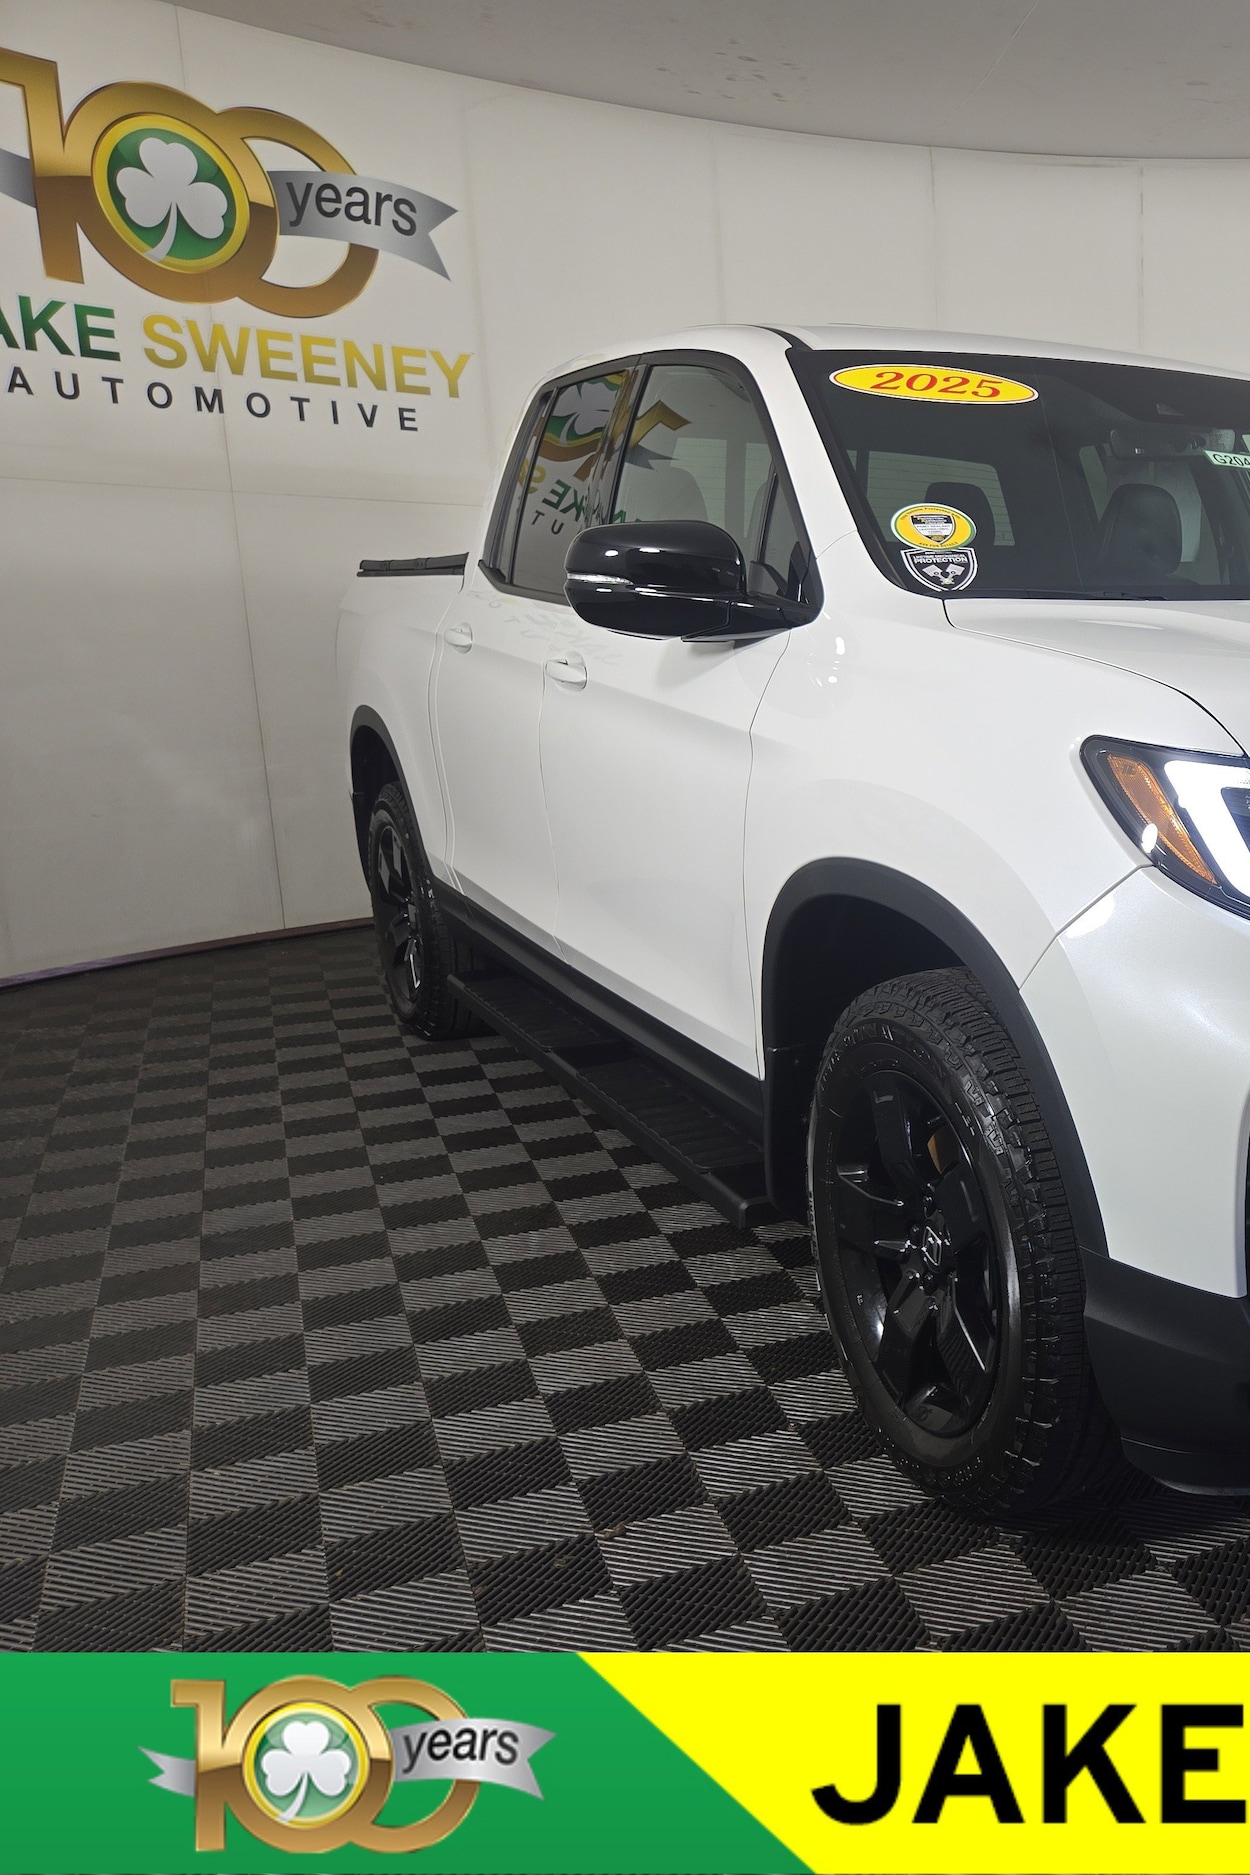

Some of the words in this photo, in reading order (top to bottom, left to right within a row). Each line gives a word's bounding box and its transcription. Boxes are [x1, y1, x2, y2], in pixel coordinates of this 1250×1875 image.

[286, 181, 418, 237] years
[142, 314, 472, 399] SWEENEY
[870, 371, 1003, 398] 2025
[7, 366, 419, 432] AUTOMOTIVE
